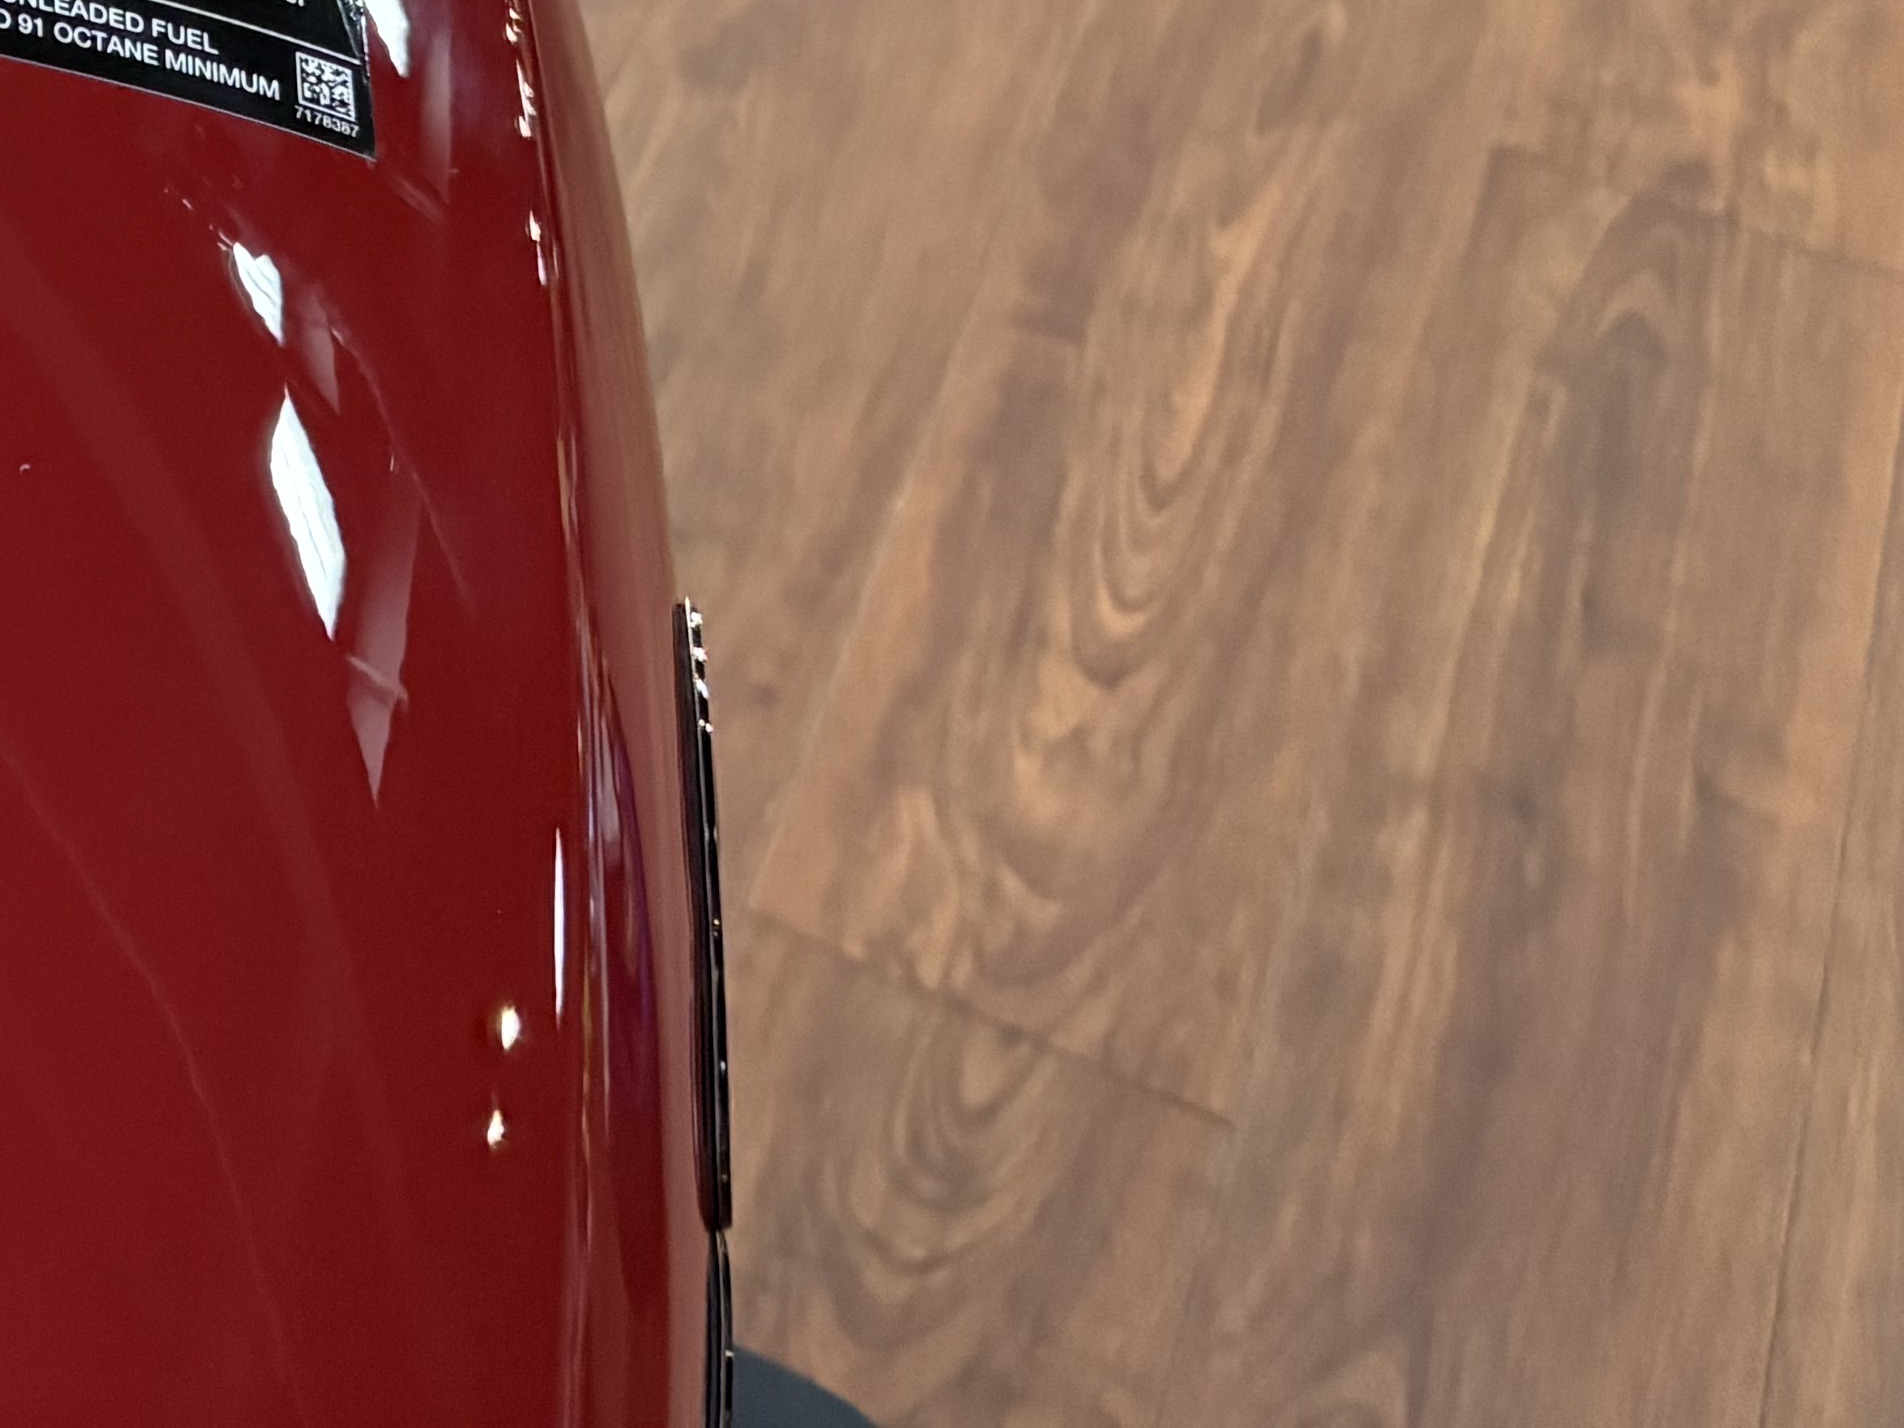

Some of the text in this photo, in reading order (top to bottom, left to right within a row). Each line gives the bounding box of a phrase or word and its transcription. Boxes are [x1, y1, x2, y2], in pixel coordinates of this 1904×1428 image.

[18, 13, 43, 37] 91
[53, 22, 159, 65] OCTANE
[165, 48, 280, 100] MINIMUM
[151, 18, 219, 55] FUEL
